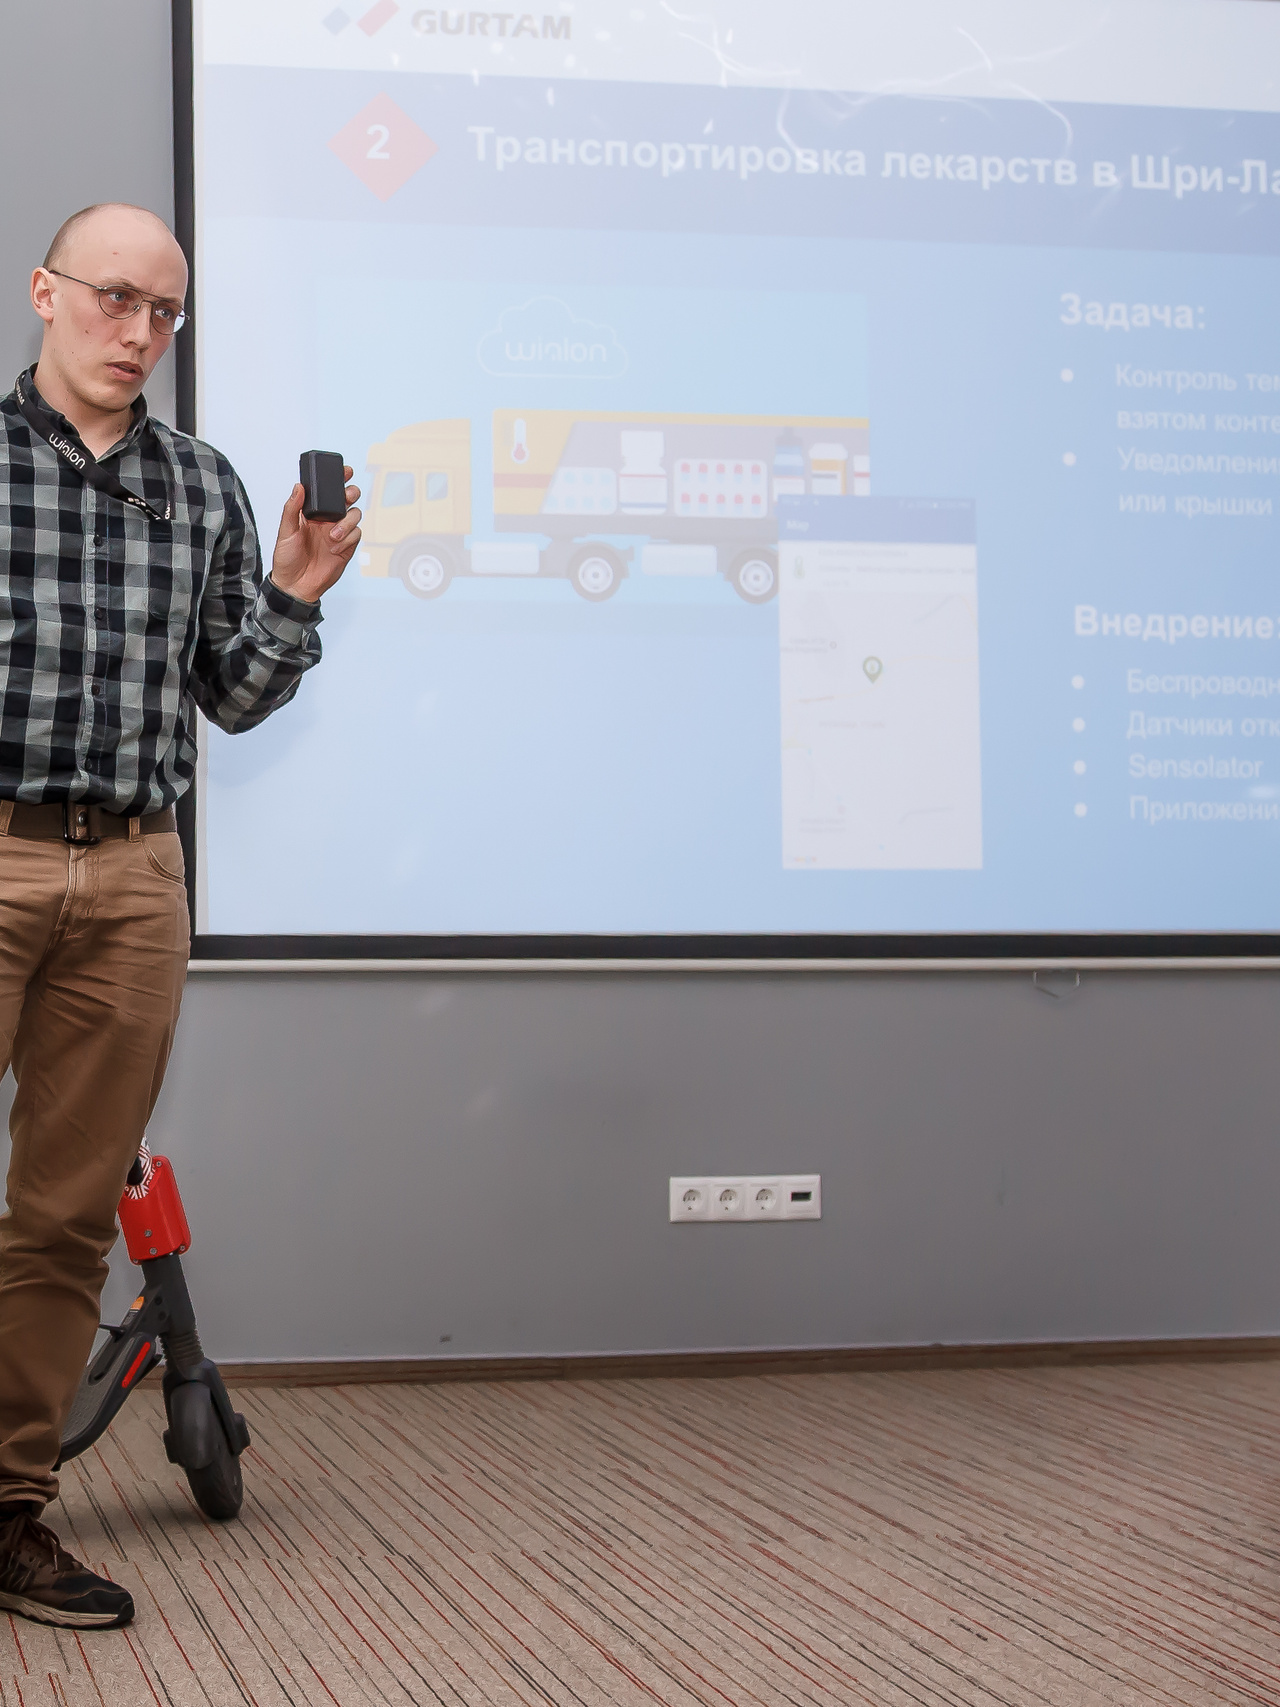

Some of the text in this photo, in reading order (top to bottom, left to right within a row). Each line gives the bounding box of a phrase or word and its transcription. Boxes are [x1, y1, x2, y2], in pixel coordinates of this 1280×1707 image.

[410, 9, 572, 40] GURTAM
[366, 124, 390, 160] 2
[467, 126, 866, 181] Транспортировка
[880, 150, 1078, 191] лекарств
[1093, 161, 1118, 188] в
[1059, 291, 1206, 331] Задача:
[505, 337, 607, 362] wialon
[1115, 363, 1237, 395] Контроль
[1116, 410, 1206, 432] взятом
[49, 433, 86, 470] wialon
[1117, 446, 1280, 476] Уведомлени
[1119, 492, 1273, 520] или крышки
[1126, 710, 1233, 740] Датчики
[1129, 752, 1264, 780] Sensolator
